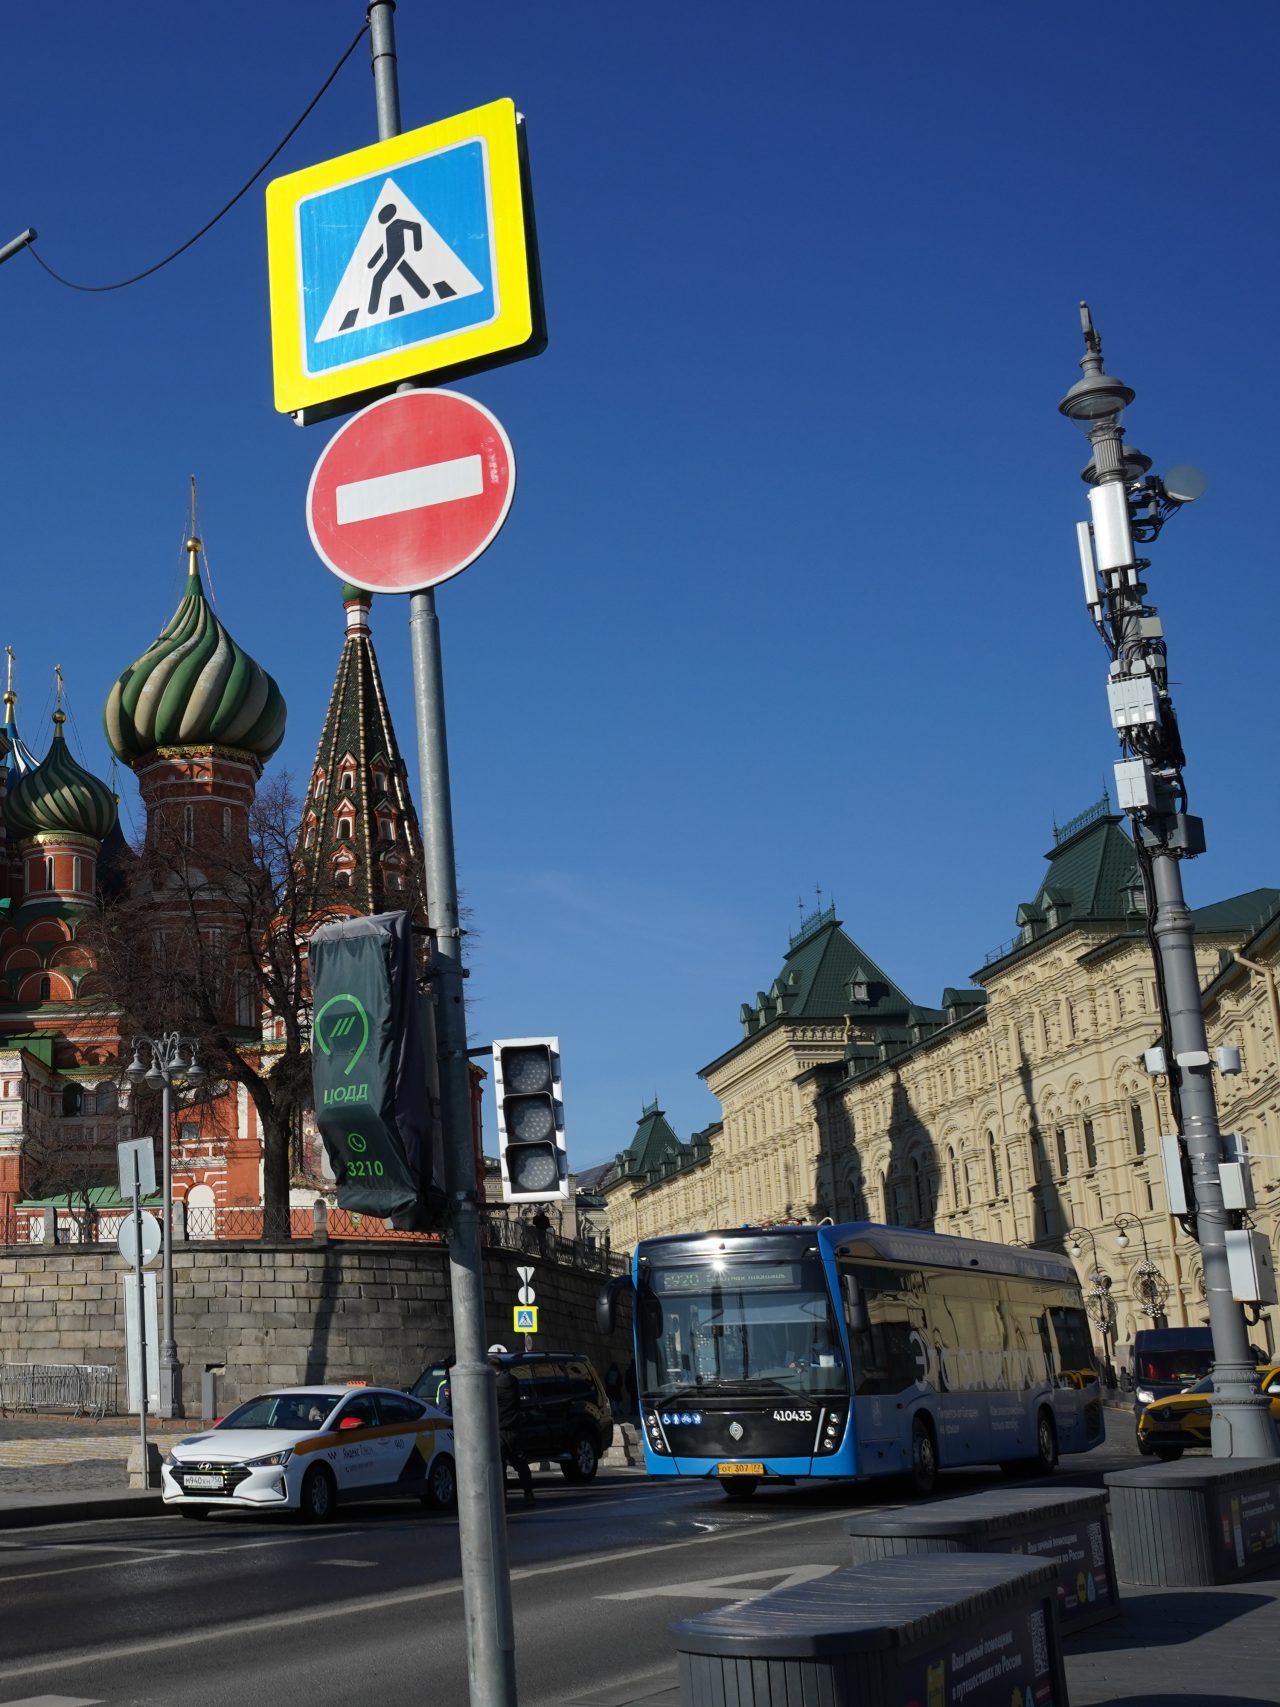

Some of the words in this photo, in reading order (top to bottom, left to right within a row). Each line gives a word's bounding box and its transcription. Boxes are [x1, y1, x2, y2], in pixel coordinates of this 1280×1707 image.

[323, 1083, 369, 1105] ЦОДД
[346, 1160, 384, 1177] 3210
[773, 1410, 813, 1422] 410435
[951, 1652, 965, 1673] Ваш
[964, 1637, 984, 1665] личный
[983, 1630, 1013, 1655] помощник
[994, 1662, 1002, 1678] по
[1001, 1653, 1022, 1675] России
